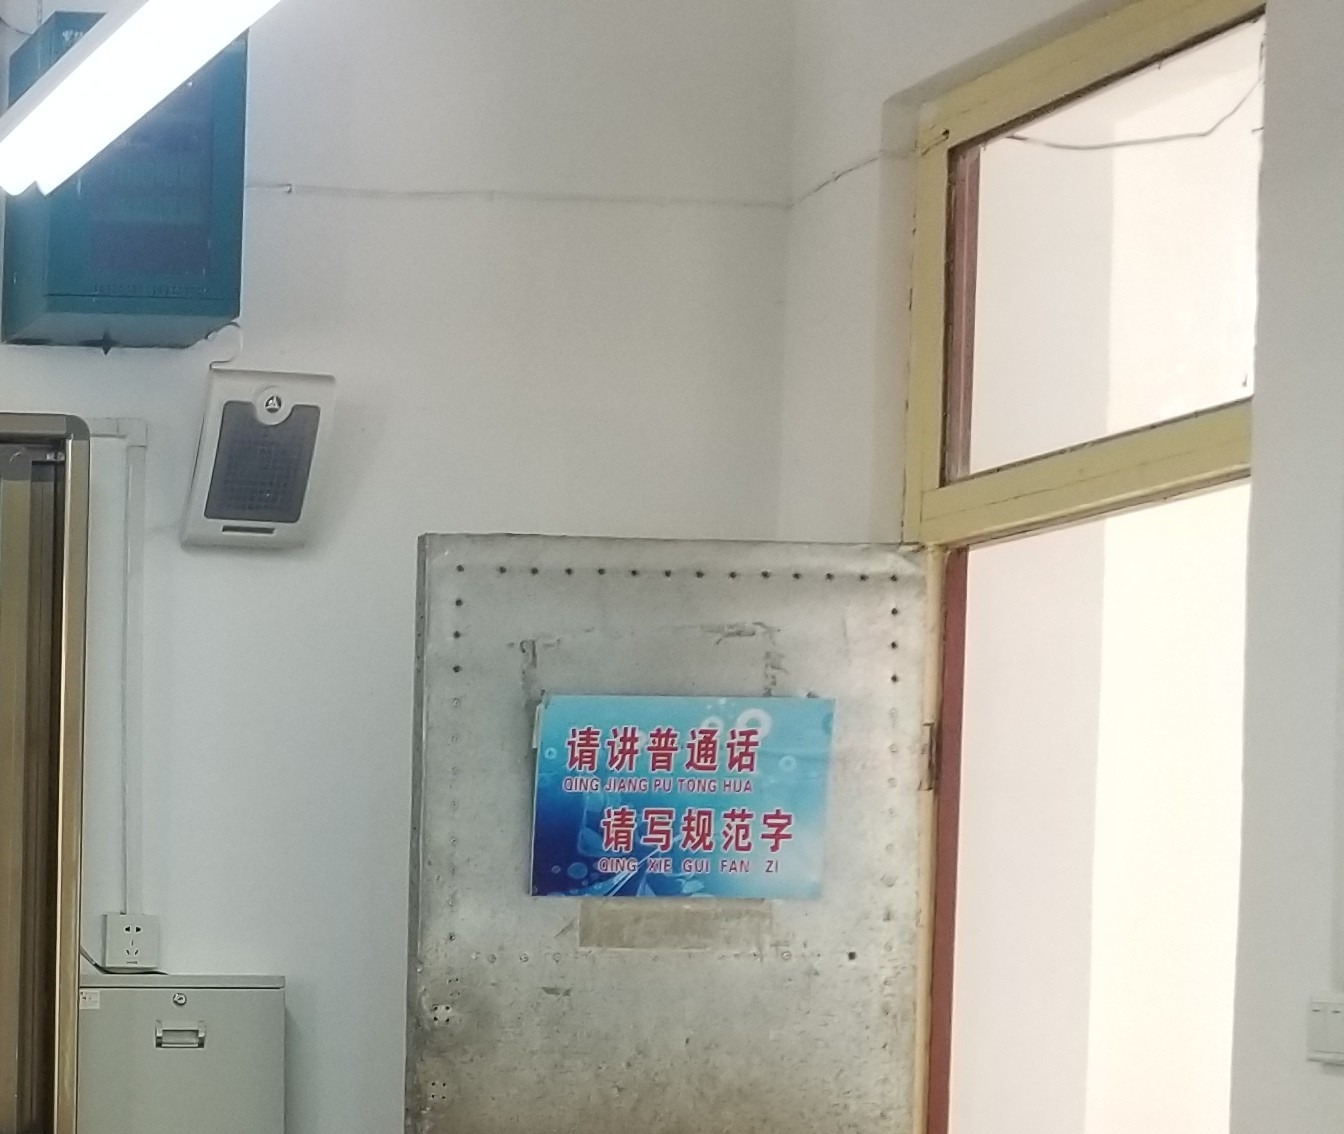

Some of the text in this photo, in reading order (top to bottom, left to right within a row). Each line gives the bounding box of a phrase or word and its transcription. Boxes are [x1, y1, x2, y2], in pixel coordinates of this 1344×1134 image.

[565, 727, 762, 773] 请讲普通话
[563, 777, 753, 793] QING JIANG PU TONG HUA
[601, 807, 795, 853] 请写规范字
[598, 857, 780, 874] QING XIE GUI FAN ZI
